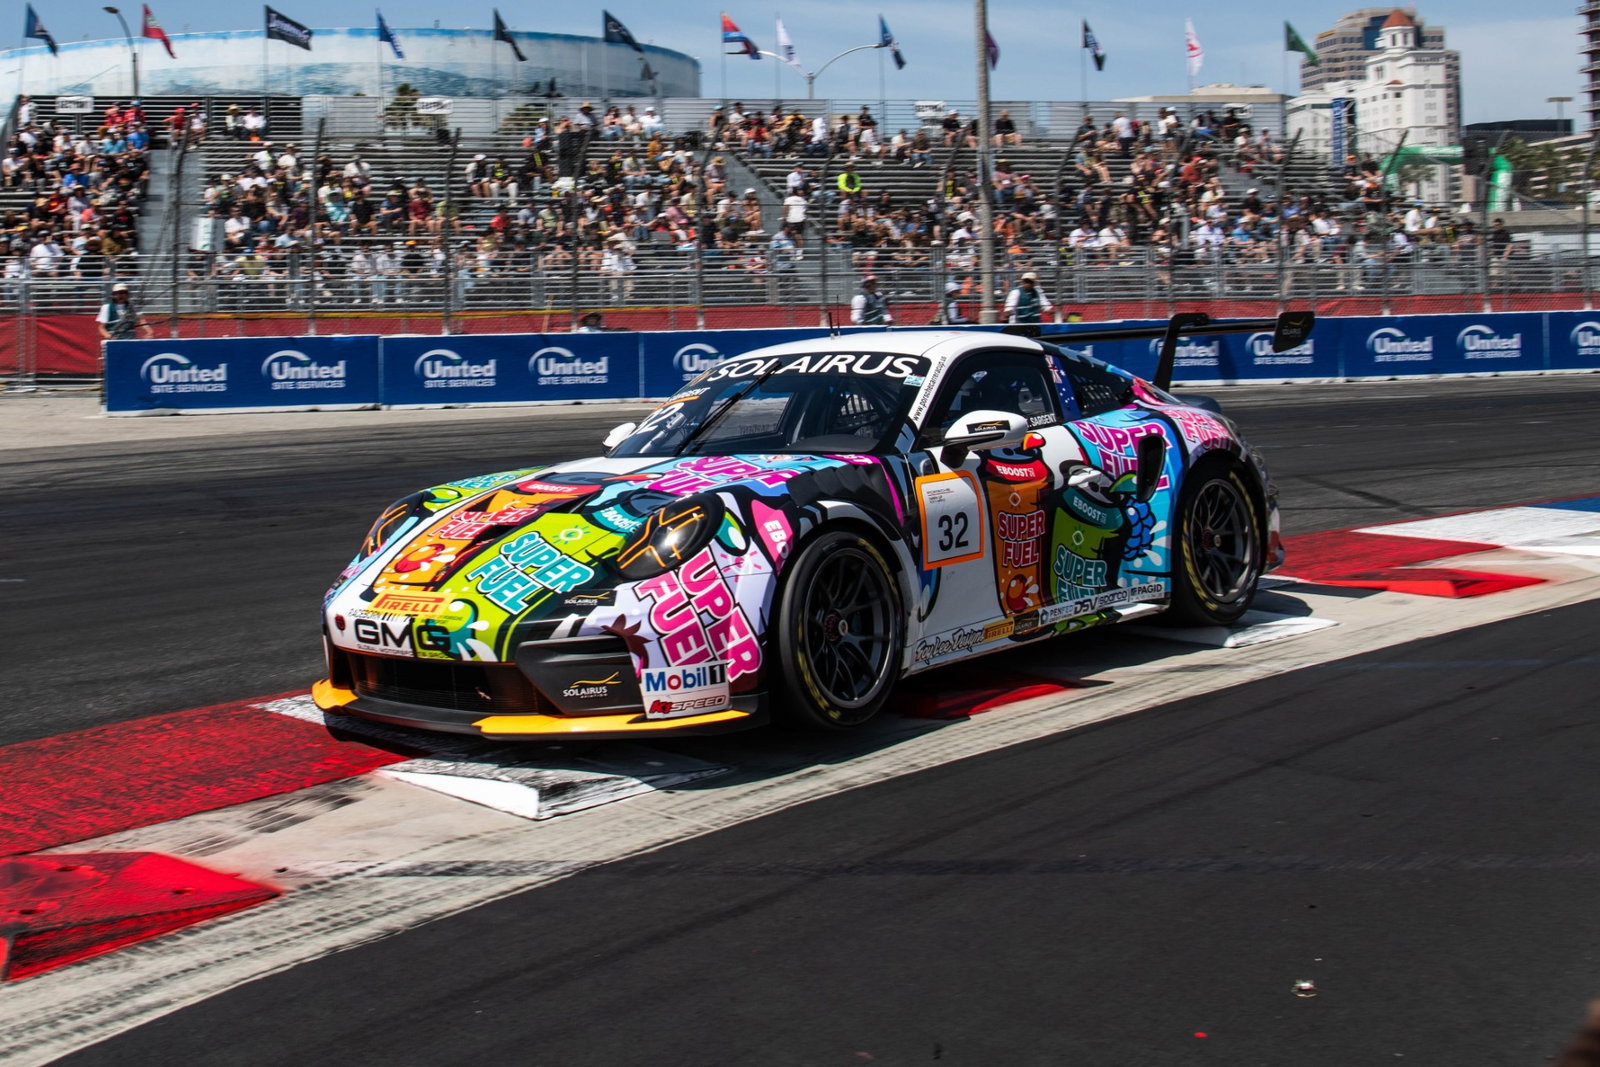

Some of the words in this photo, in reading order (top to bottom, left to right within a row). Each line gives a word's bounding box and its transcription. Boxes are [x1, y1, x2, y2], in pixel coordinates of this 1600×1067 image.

[1374, 336, 1433, 353] United
[1464, 333, 1521, 350] United
[150, 363, 228, 384] United
[271, 360, 347, 380] United
[423, 358, 497, 379] United
[537, 356, 608, 376] United
[706, 353, 920, 382] SOLAIRUS
[151, 384, 174, 394] SITE
[176, 383, 227, 393] SERVICES
[271, 381, 294, 390] SITE
[296, 379, 346, 390] SERVICES
[424, 379, 448, 388] SITE
[449, 378, 496, 388] SERVICES
[537, 376, 560, 385] SITE
[562, 375, 608, 385] SERVICES
[996, 465, 1028, 477] EBOOST
[1073, 496, 1101, 520] EBOOST
[938, 511, 968, 551] 32
[998, 510, 1046, 540] SUPER
[500, 532, 595, 594] SUPER
[1002, 539, 1039, 568] FUEL
[1054, 544, 1108, 587] SUPER
[466, 555, 543, 614] FUEL
[1137, 583, 1163, 594] PAGID
[374, 593, 446, 613] PIRELLI
[1074, 598, 1098, 615] DSV
[1098, 590, 1128, 606] sparco
[679, 547, 762, 682] UPER
[354, 618, 452, 651] GMG
[984, 620, 1014, 640] PIRELLI
[645, 666, 707, 691] Mobil
[710, 663, 726, 685] 1
[563, 686, 608, 697] SOLAIRUS
[669, 695, 726, 711] SPEED
